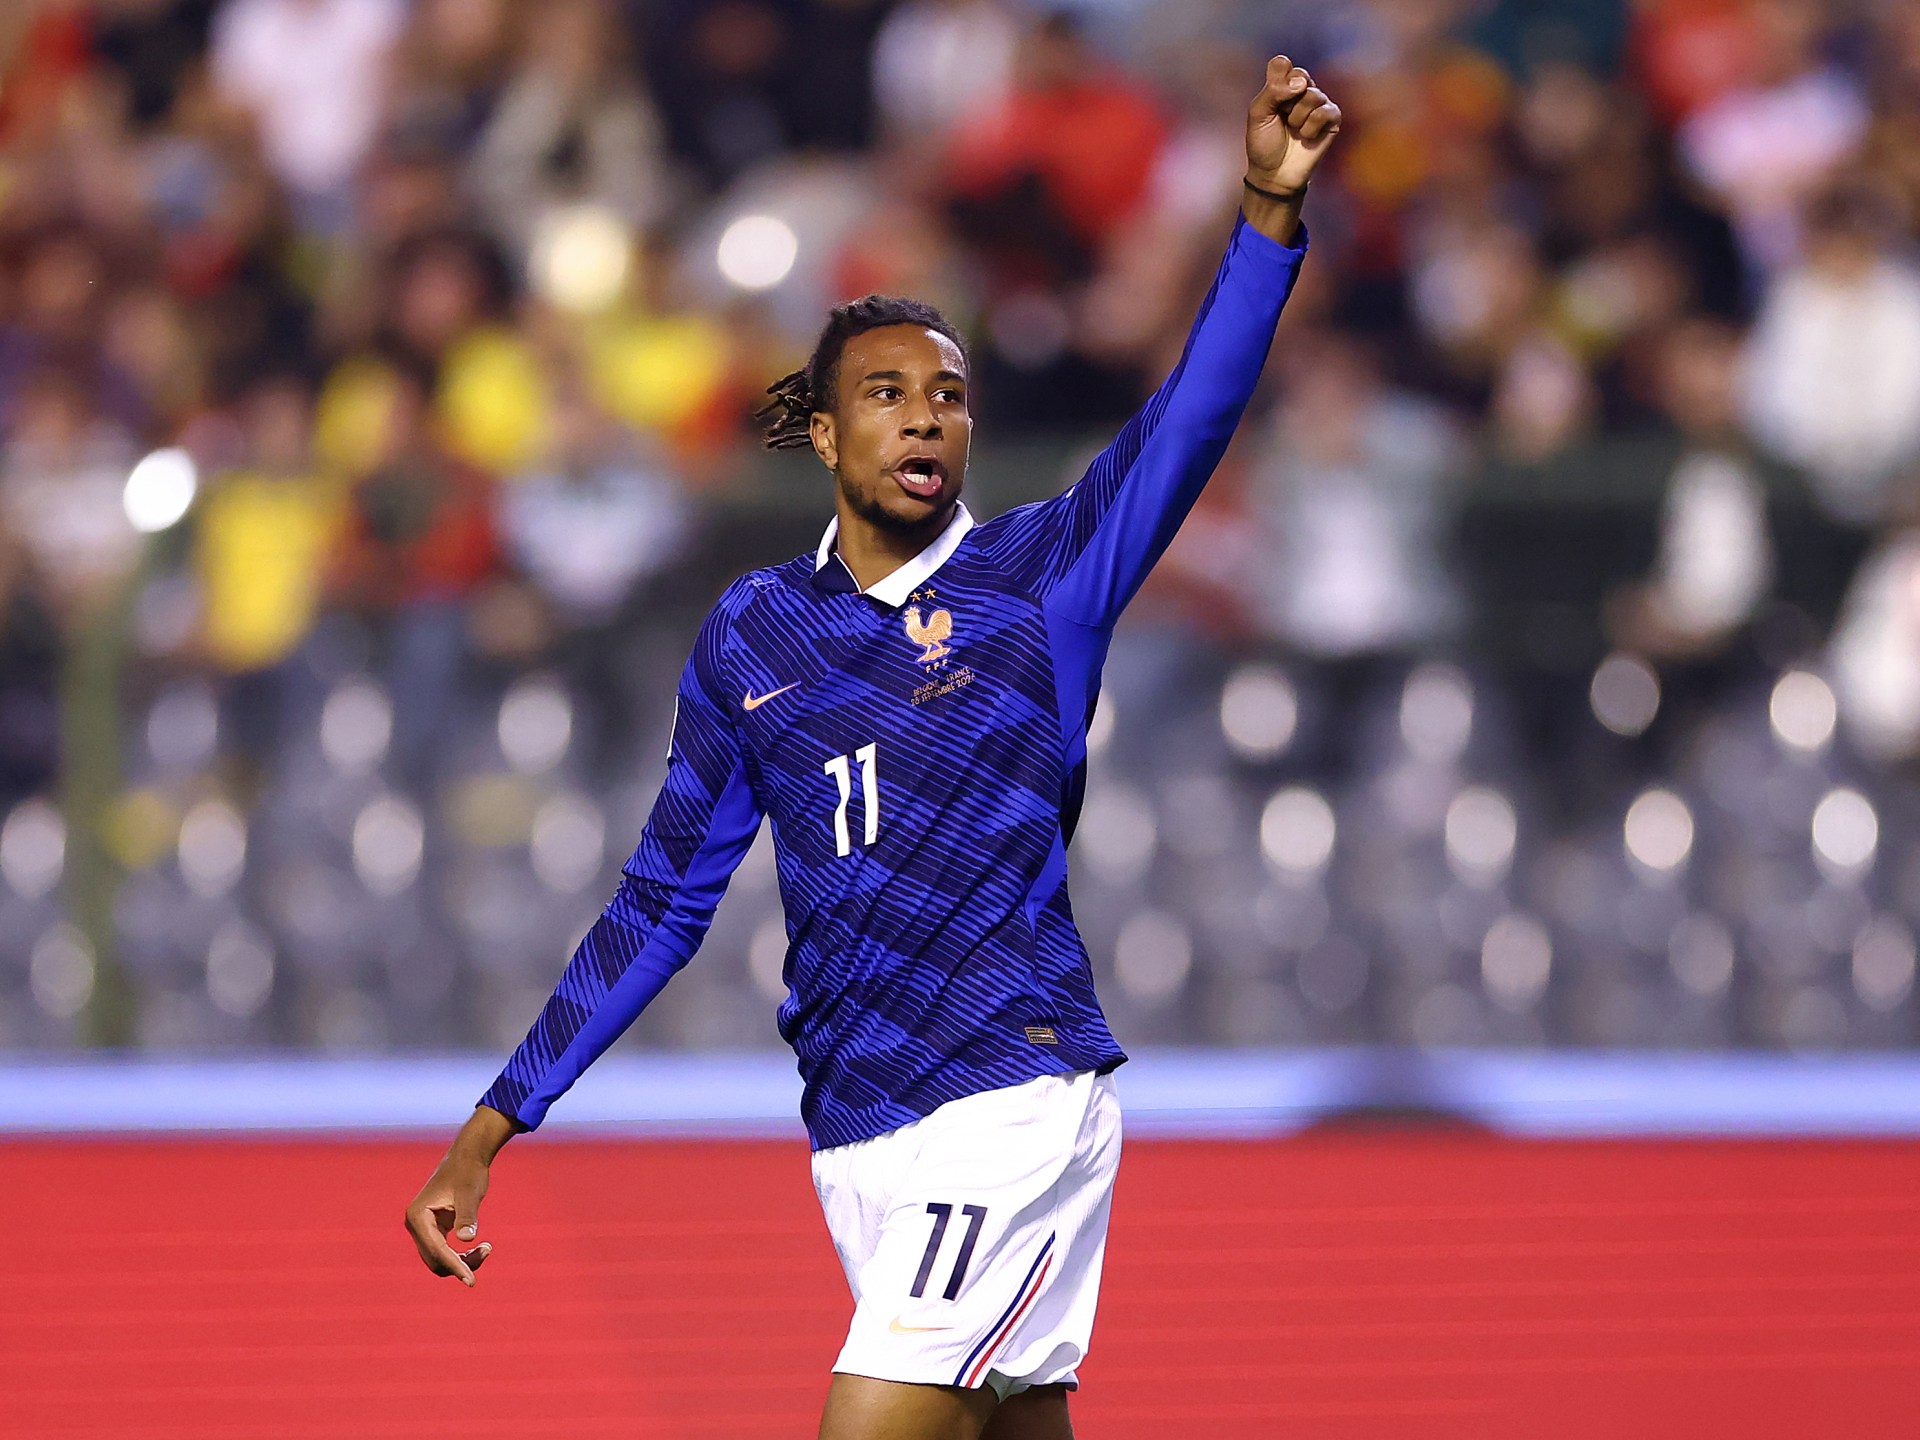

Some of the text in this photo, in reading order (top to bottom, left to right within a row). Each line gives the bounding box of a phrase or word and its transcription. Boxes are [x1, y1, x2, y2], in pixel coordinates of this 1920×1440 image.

[946, 666, 970, 682] FRANCE
[824, 743, 879, 857] 11
[909, 1202, 988, 1301] 11
